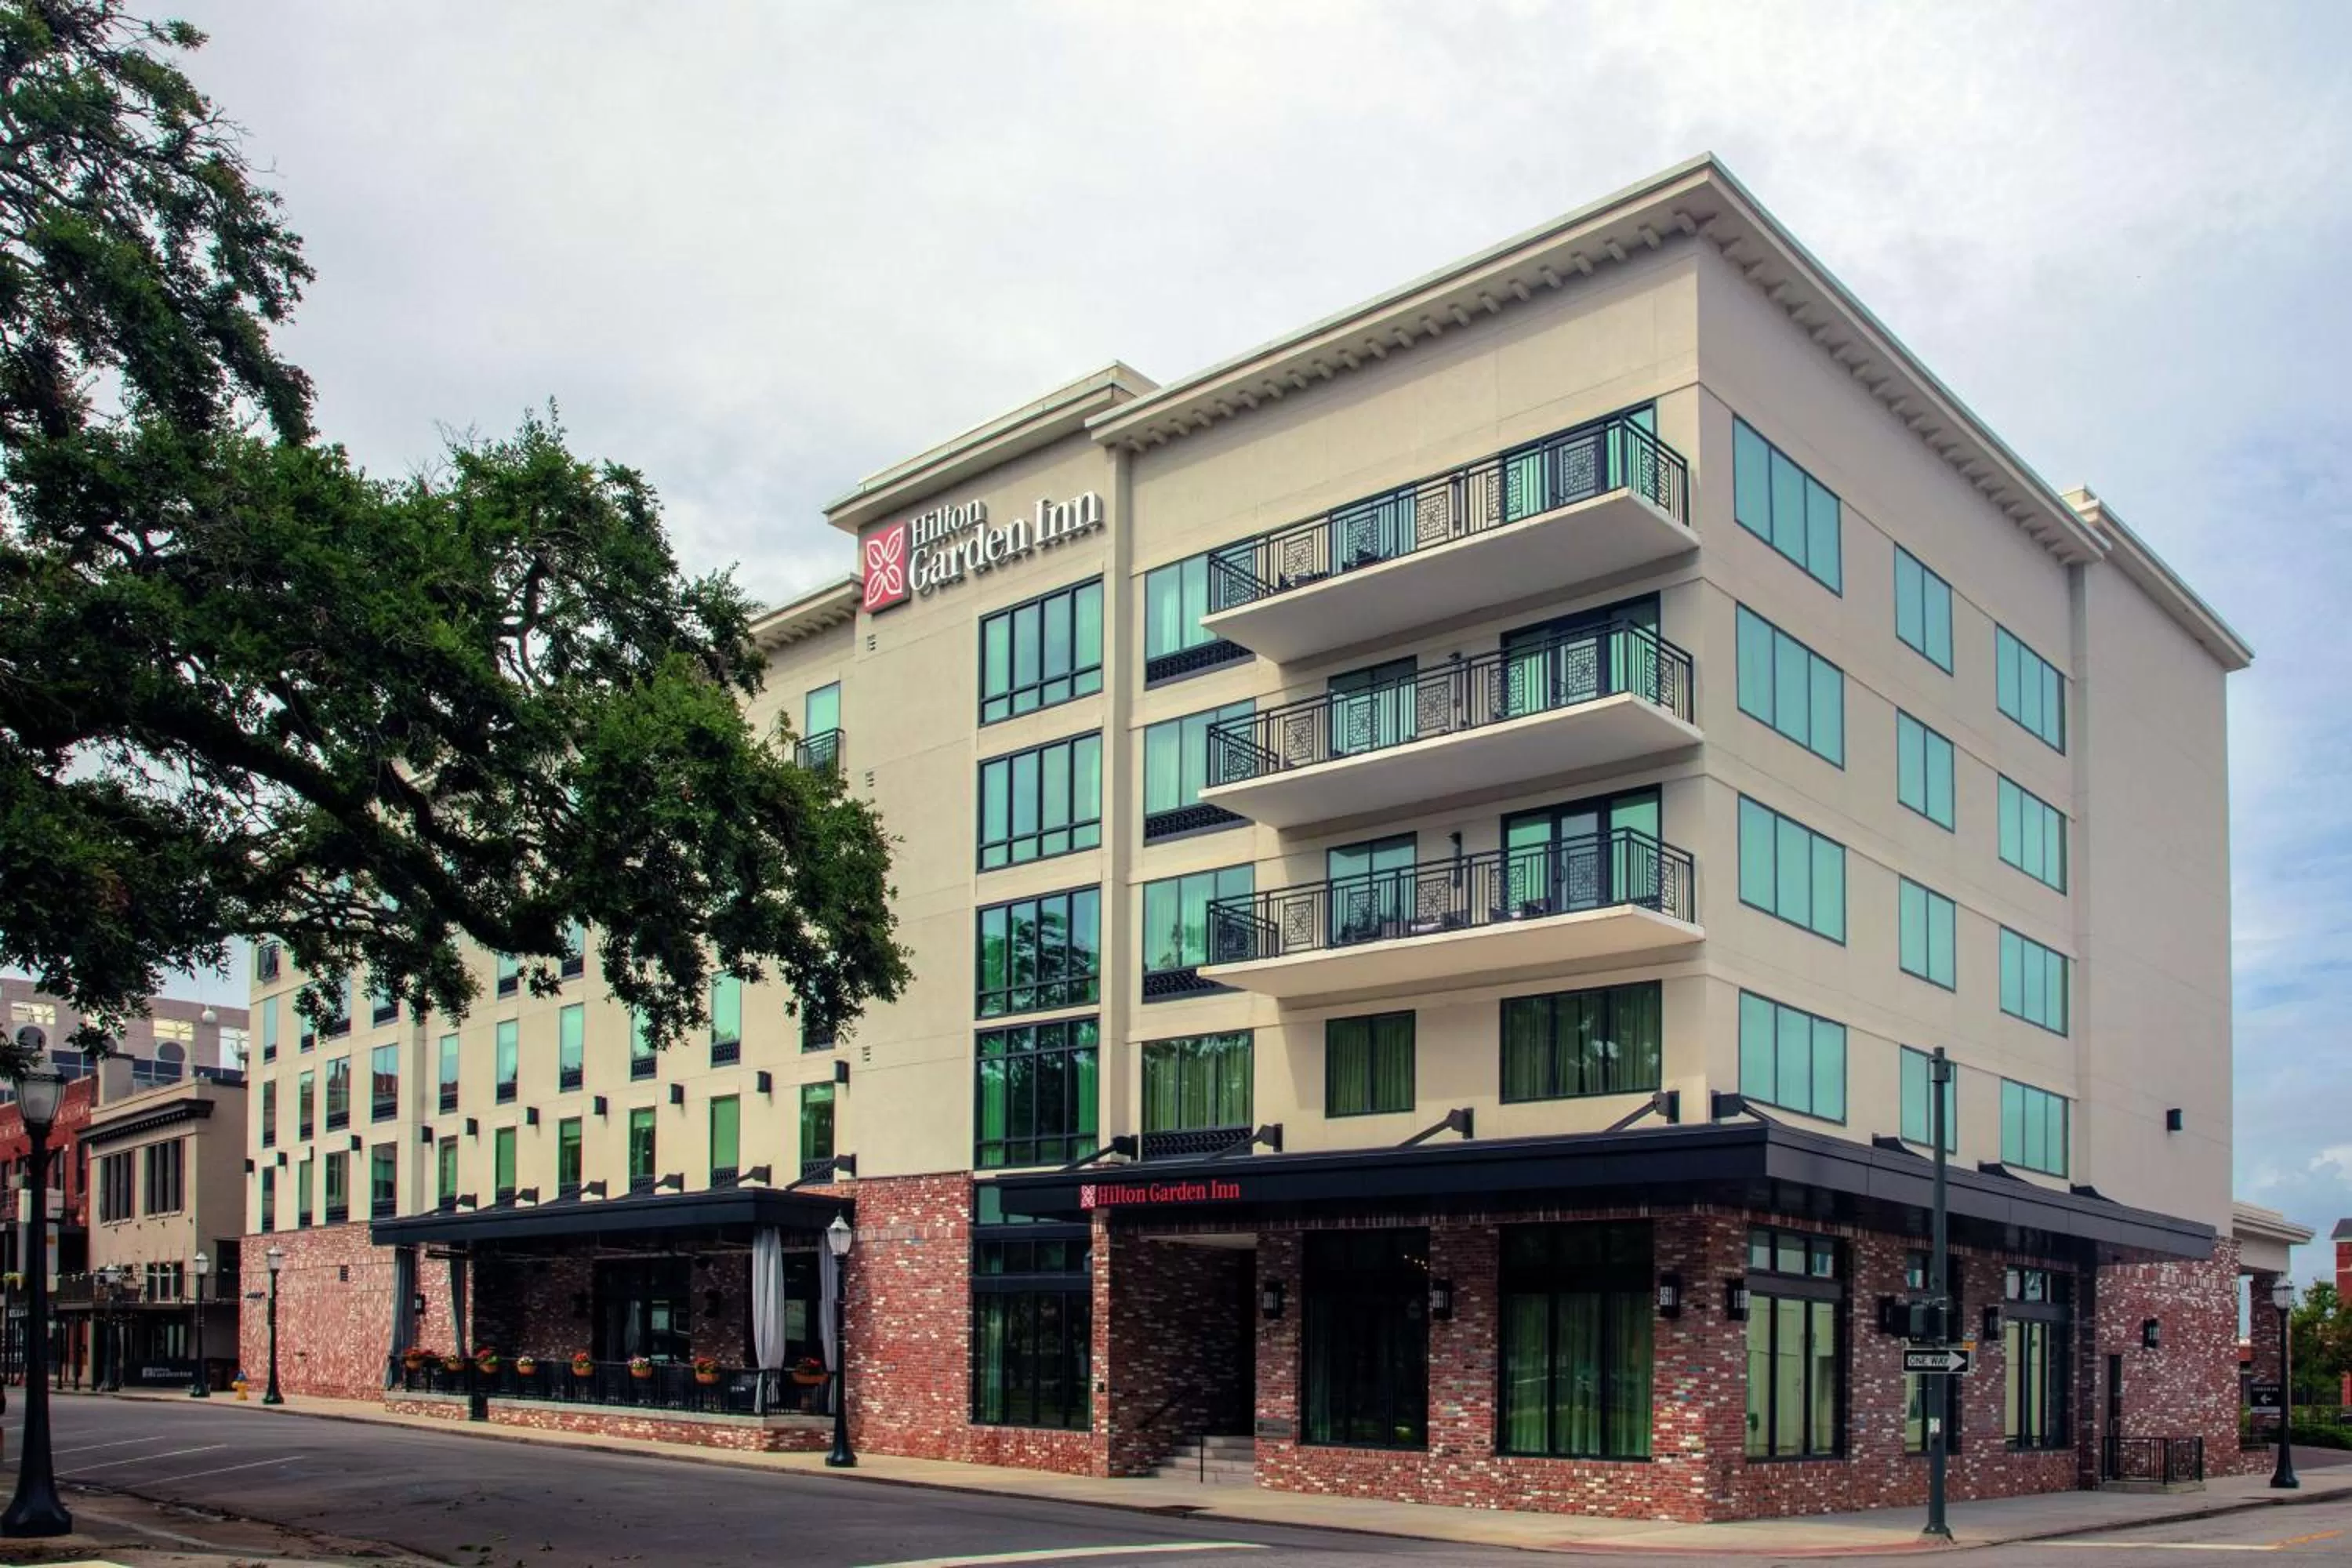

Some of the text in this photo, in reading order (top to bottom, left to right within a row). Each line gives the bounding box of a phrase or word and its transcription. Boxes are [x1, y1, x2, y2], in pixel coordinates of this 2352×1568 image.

[909, 489, 1101, 590] Garden Inn
[911, 499, 983, 549] Hilton
[1098, 1178, 1240, 1205] Hilton Garden Inn
[1909, 1356, 1949, 1366] ONE WAY
